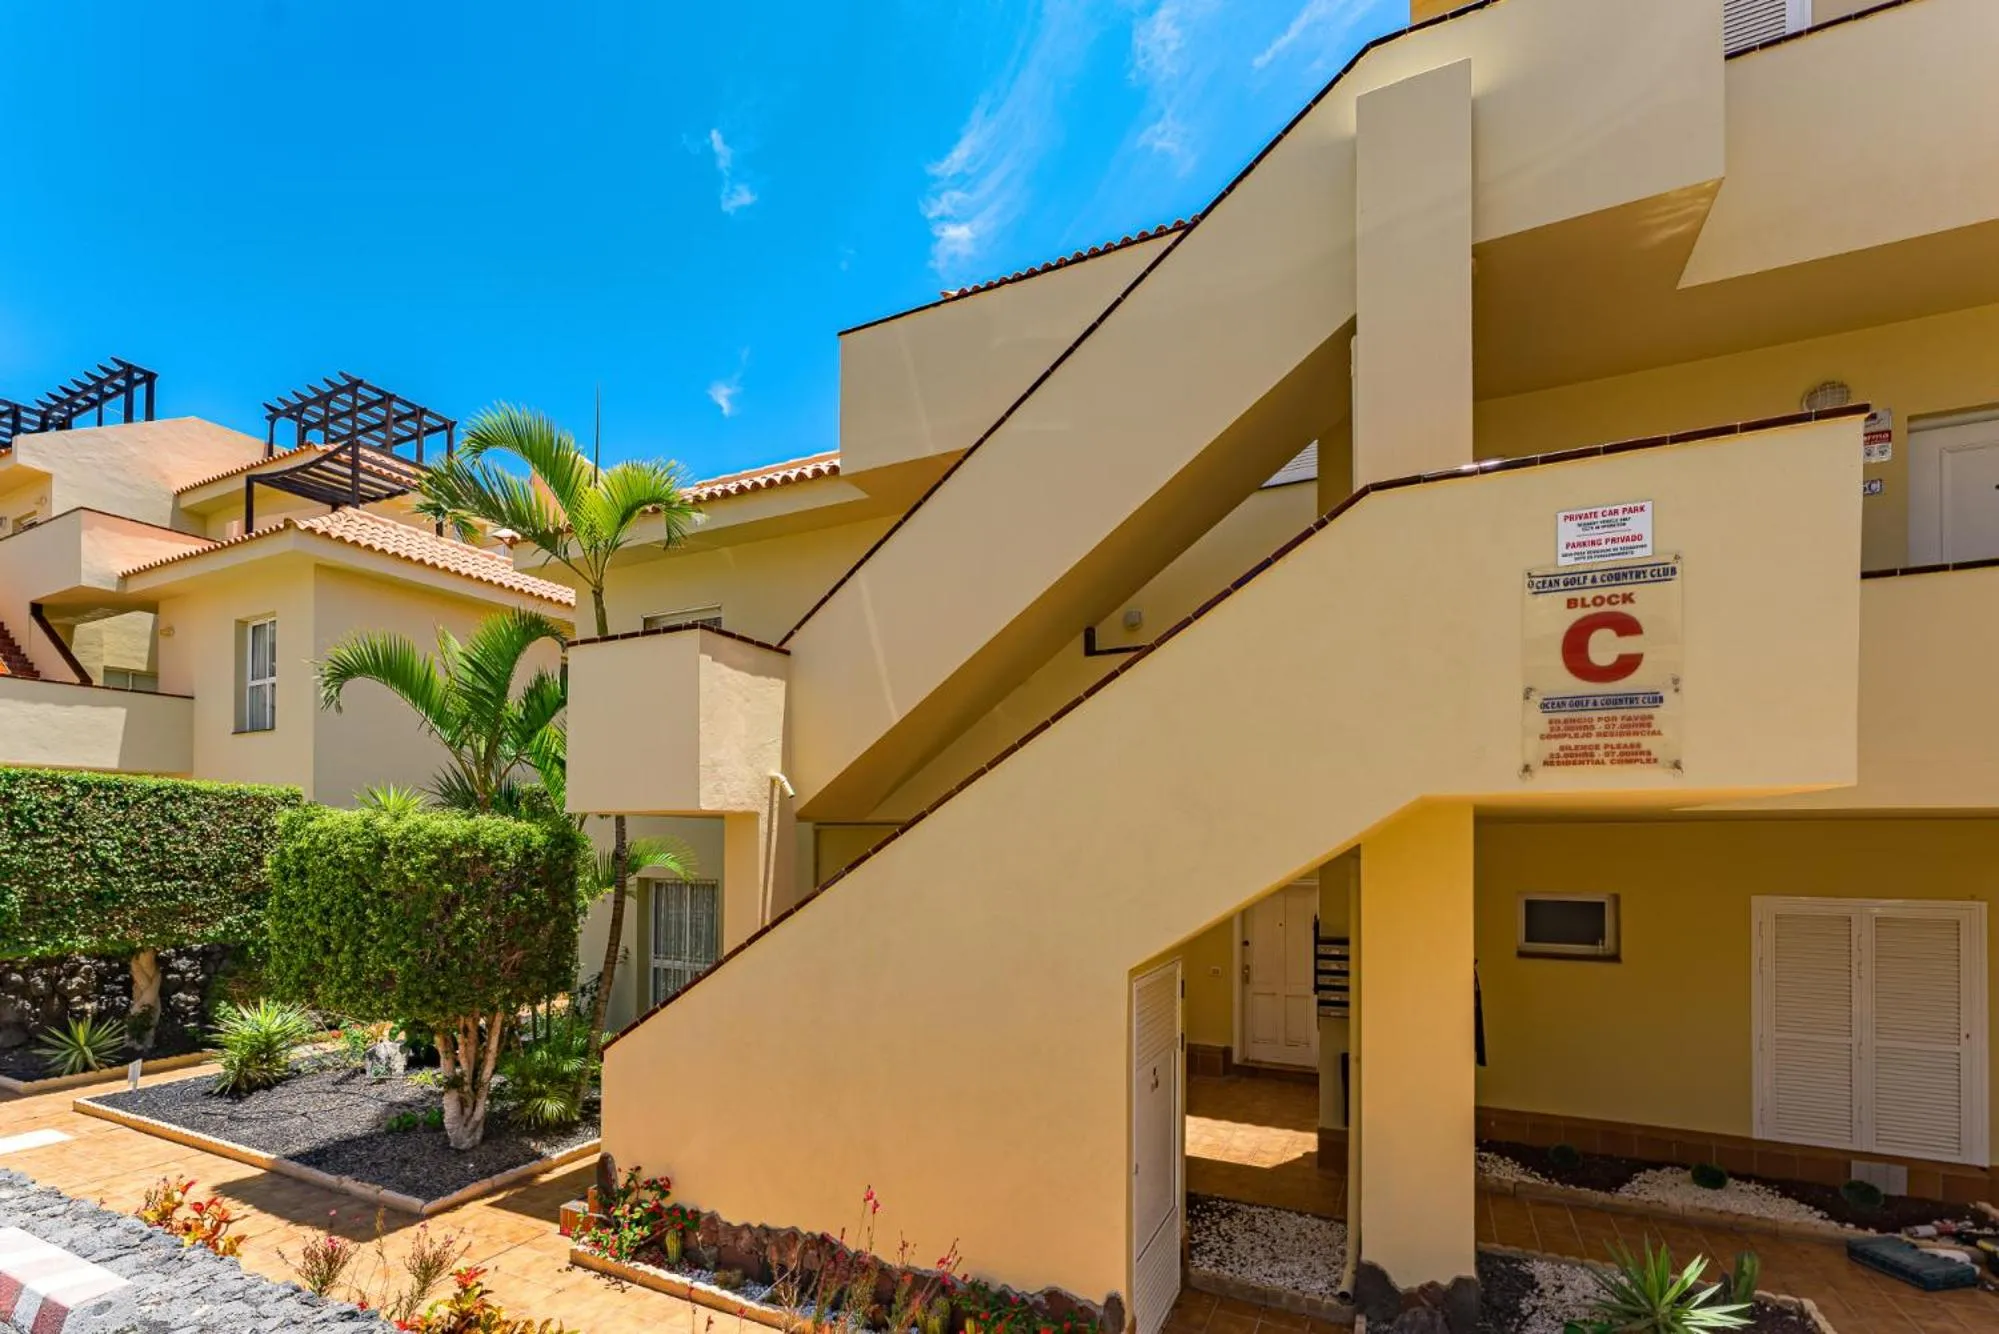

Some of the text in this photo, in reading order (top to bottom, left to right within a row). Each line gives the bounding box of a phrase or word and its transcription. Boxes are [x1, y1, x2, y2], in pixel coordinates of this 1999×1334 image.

[1563, 510, 1598, 522] PRIVATE
[1601, 508, 1619, 518] CAR
[1622, 505, 1646, 515] PARK
[1565, 534, 1643, 550] PARKING PRIVADO
[1527, 566, 1677, 590] OCEAN GOLF & COUNTRY CLUB
[1566, 592, 1636, 610] BLOCK
[1561, 611, 1644, 684] C
[1539, 700, 1567, 711] OCEAN
[1568, 698, 1590, 709] GOLF
[1600, 696, 1640, 707] COUNTRY
[1597, 715, 1618, 723] POR
